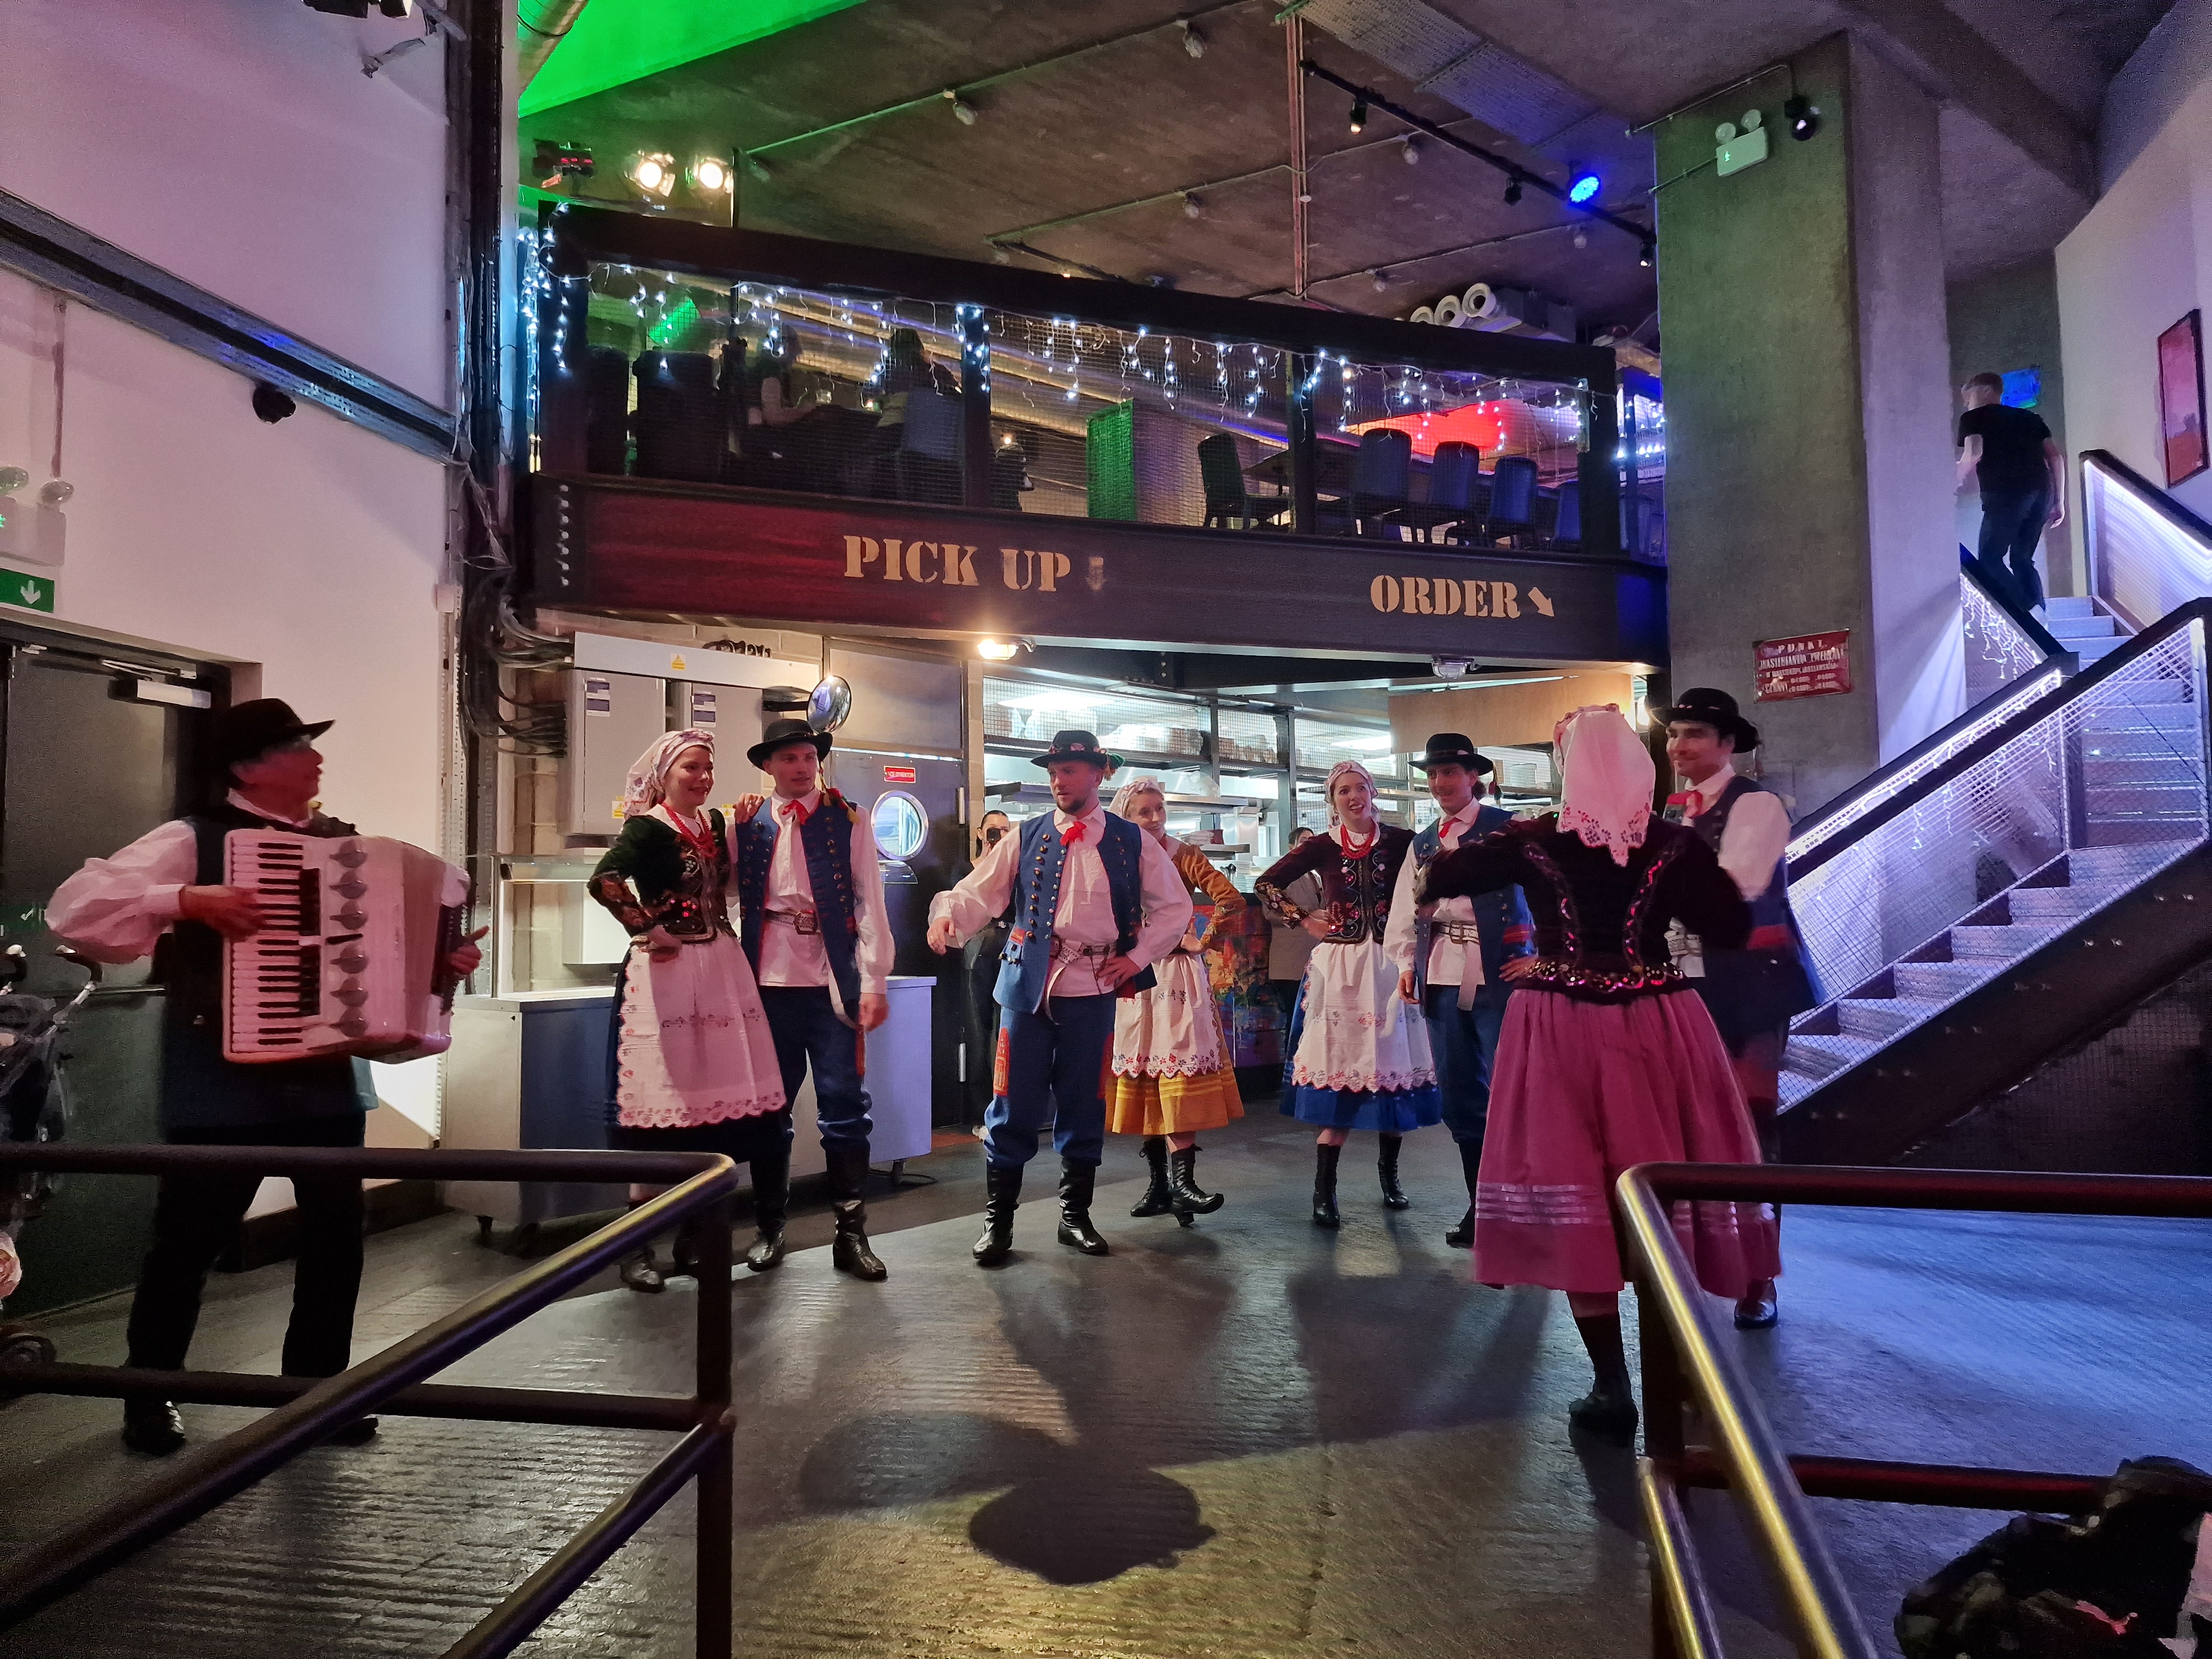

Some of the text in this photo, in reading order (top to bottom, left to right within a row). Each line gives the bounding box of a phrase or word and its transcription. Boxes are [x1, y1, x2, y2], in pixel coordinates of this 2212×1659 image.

[843, 535, 1071, 591] PICK UP
[1370, 575, 1521, 619] ORDER
